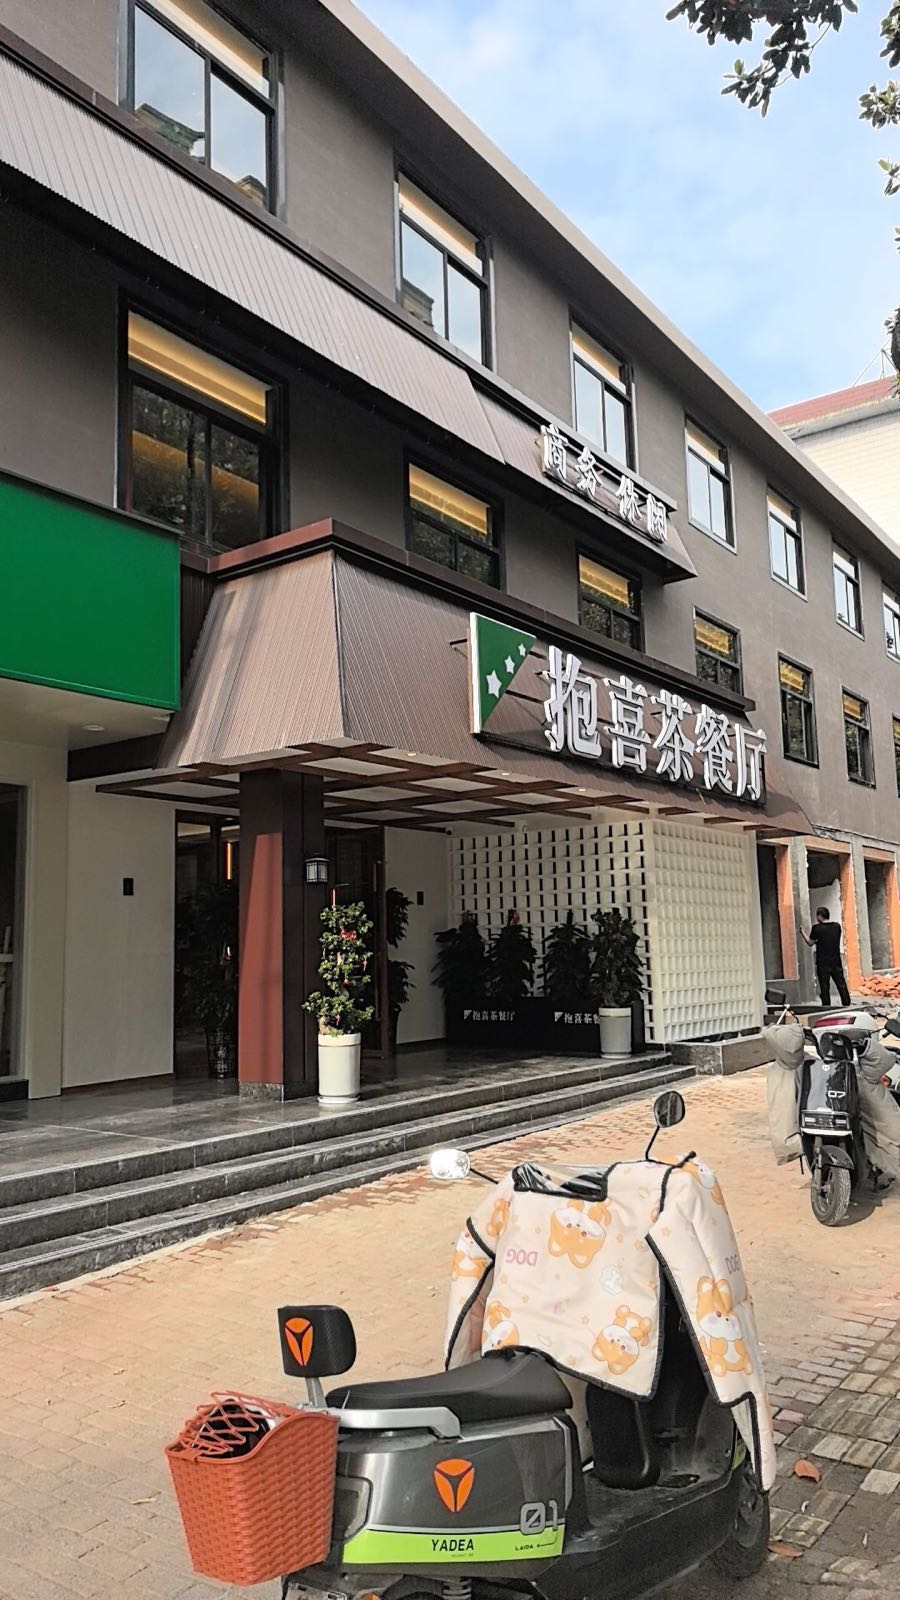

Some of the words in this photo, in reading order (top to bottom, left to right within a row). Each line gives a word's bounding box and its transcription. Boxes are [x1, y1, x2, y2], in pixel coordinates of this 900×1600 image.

[541, 424, 667, 544] 商务休闲
[543, 645, 767, 800] 抱喜茶餐厅
[431, 1538, 474, 1552] YADEA
